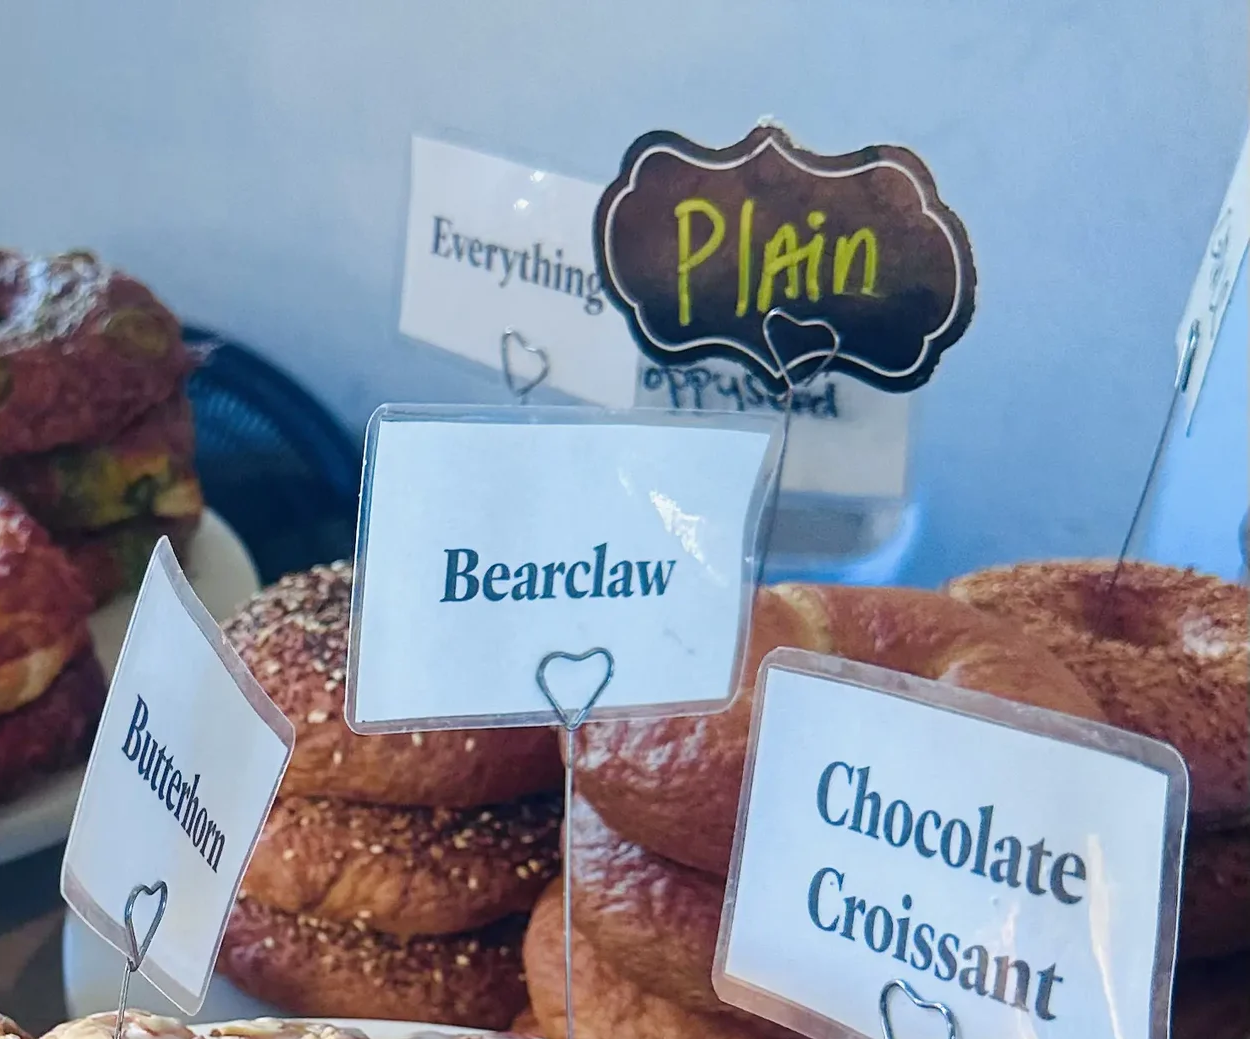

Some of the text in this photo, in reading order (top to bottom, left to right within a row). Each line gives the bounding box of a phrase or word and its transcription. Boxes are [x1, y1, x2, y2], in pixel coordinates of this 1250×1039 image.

[431, 215, 605, 316] Everything
[440, 541, 677, 604] Bearclaw
[120, 693, 228, 874] Butterhorn
[816, 760, 1088, 905] Chocolate
[807, 866, 1064, 1022] Croissant
